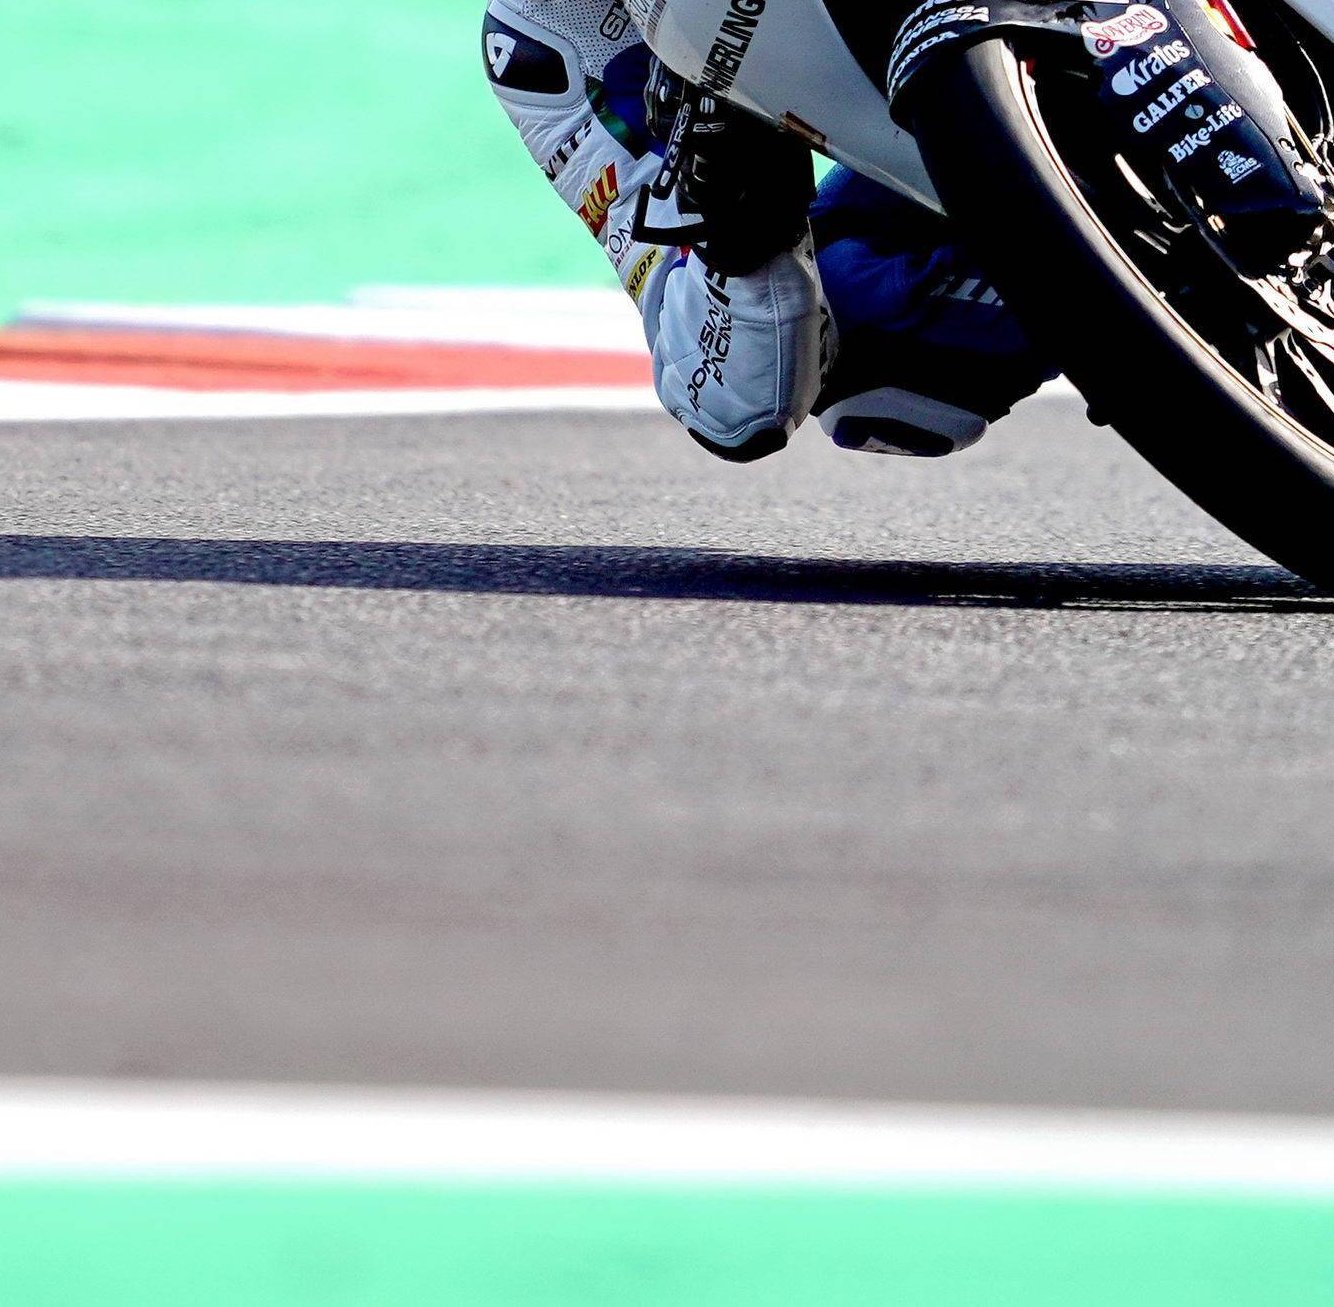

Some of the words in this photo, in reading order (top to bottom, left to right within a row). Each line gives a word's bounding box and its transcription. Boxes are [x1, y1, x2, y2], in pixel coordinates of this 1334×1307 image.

[1111, 39, 1192, 96] Kratos
[1133, 68, 1212, 133] GALFER
[1168, 102, 1244, 164] Bike-Lift
[626, 248, 658, 298] NLOP
